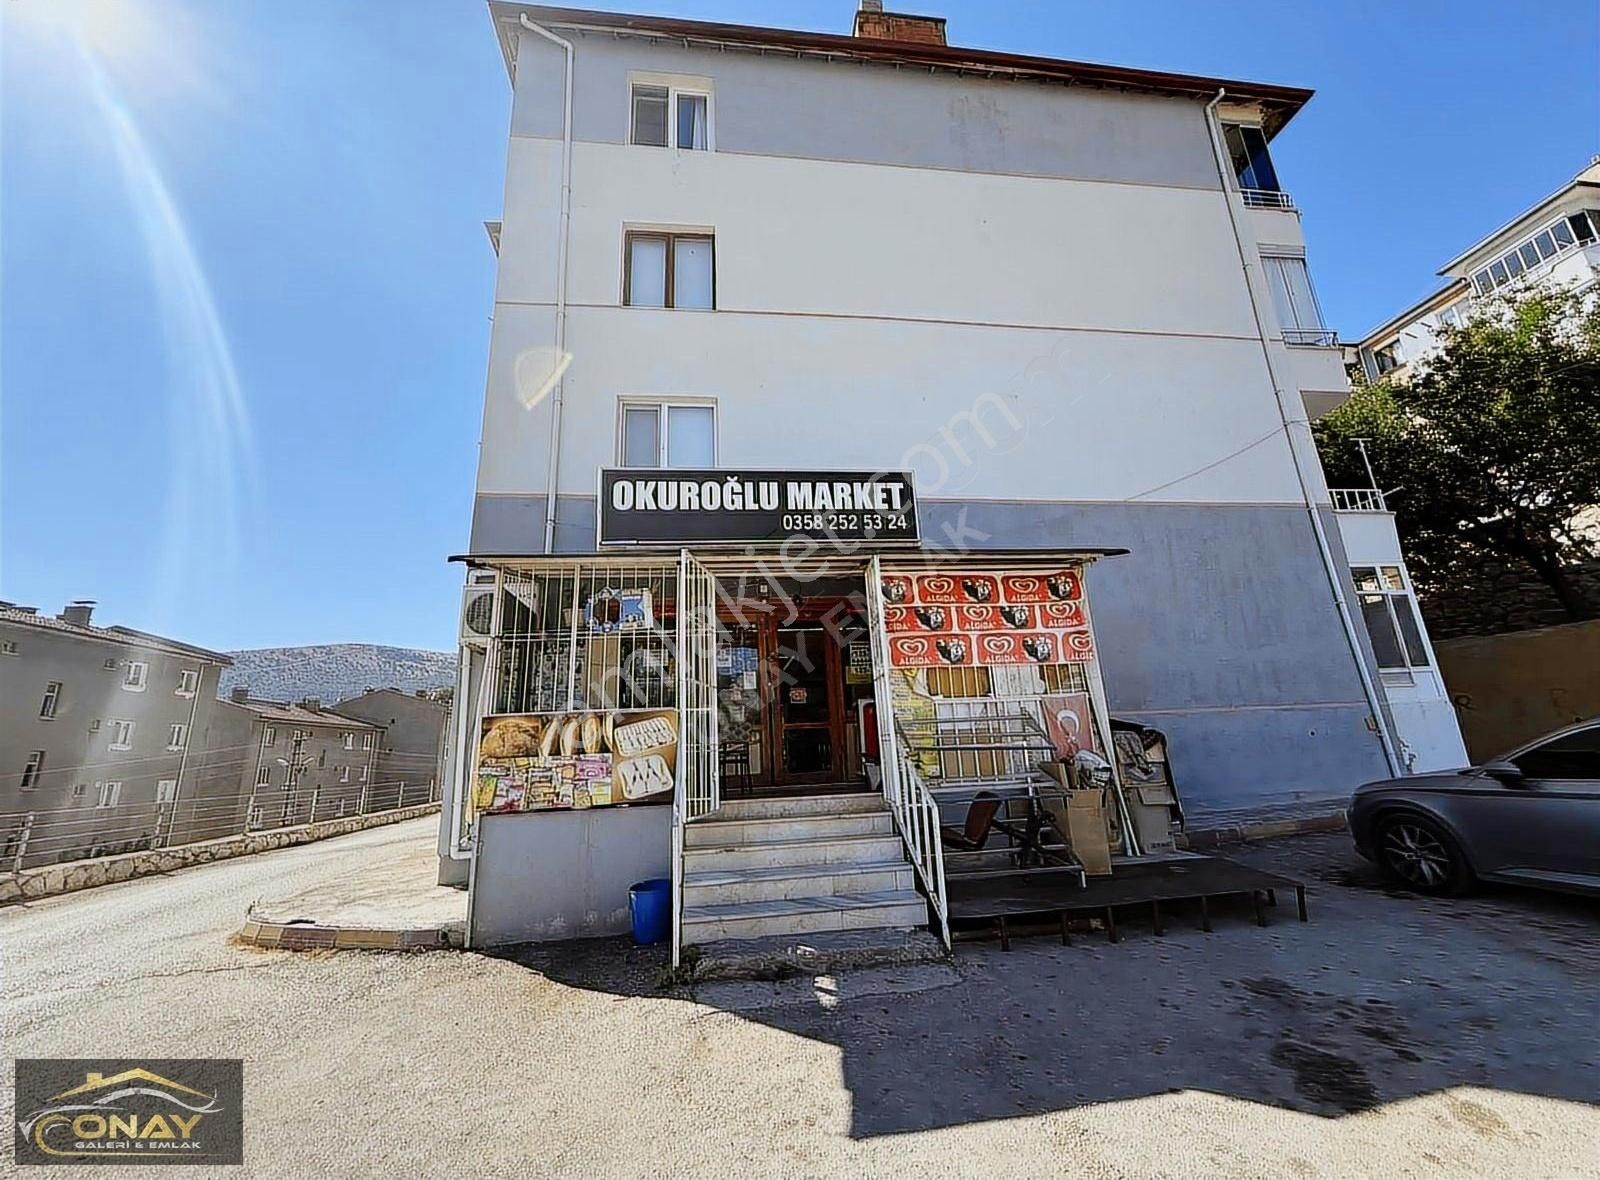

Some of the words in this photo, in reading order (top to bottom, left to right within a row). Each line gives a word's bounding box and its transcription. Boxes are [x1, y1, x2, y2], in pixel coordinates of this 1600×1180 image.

[611, 475, 779, 511] OKUROĞLU
[786, 481, 905, 510] MARKET
[782, 514, 824, 530] 0358
[829, 514, 858, 530] 252
[863, 514, 883, 529] 53
[888, 514, 908, 529] 24
